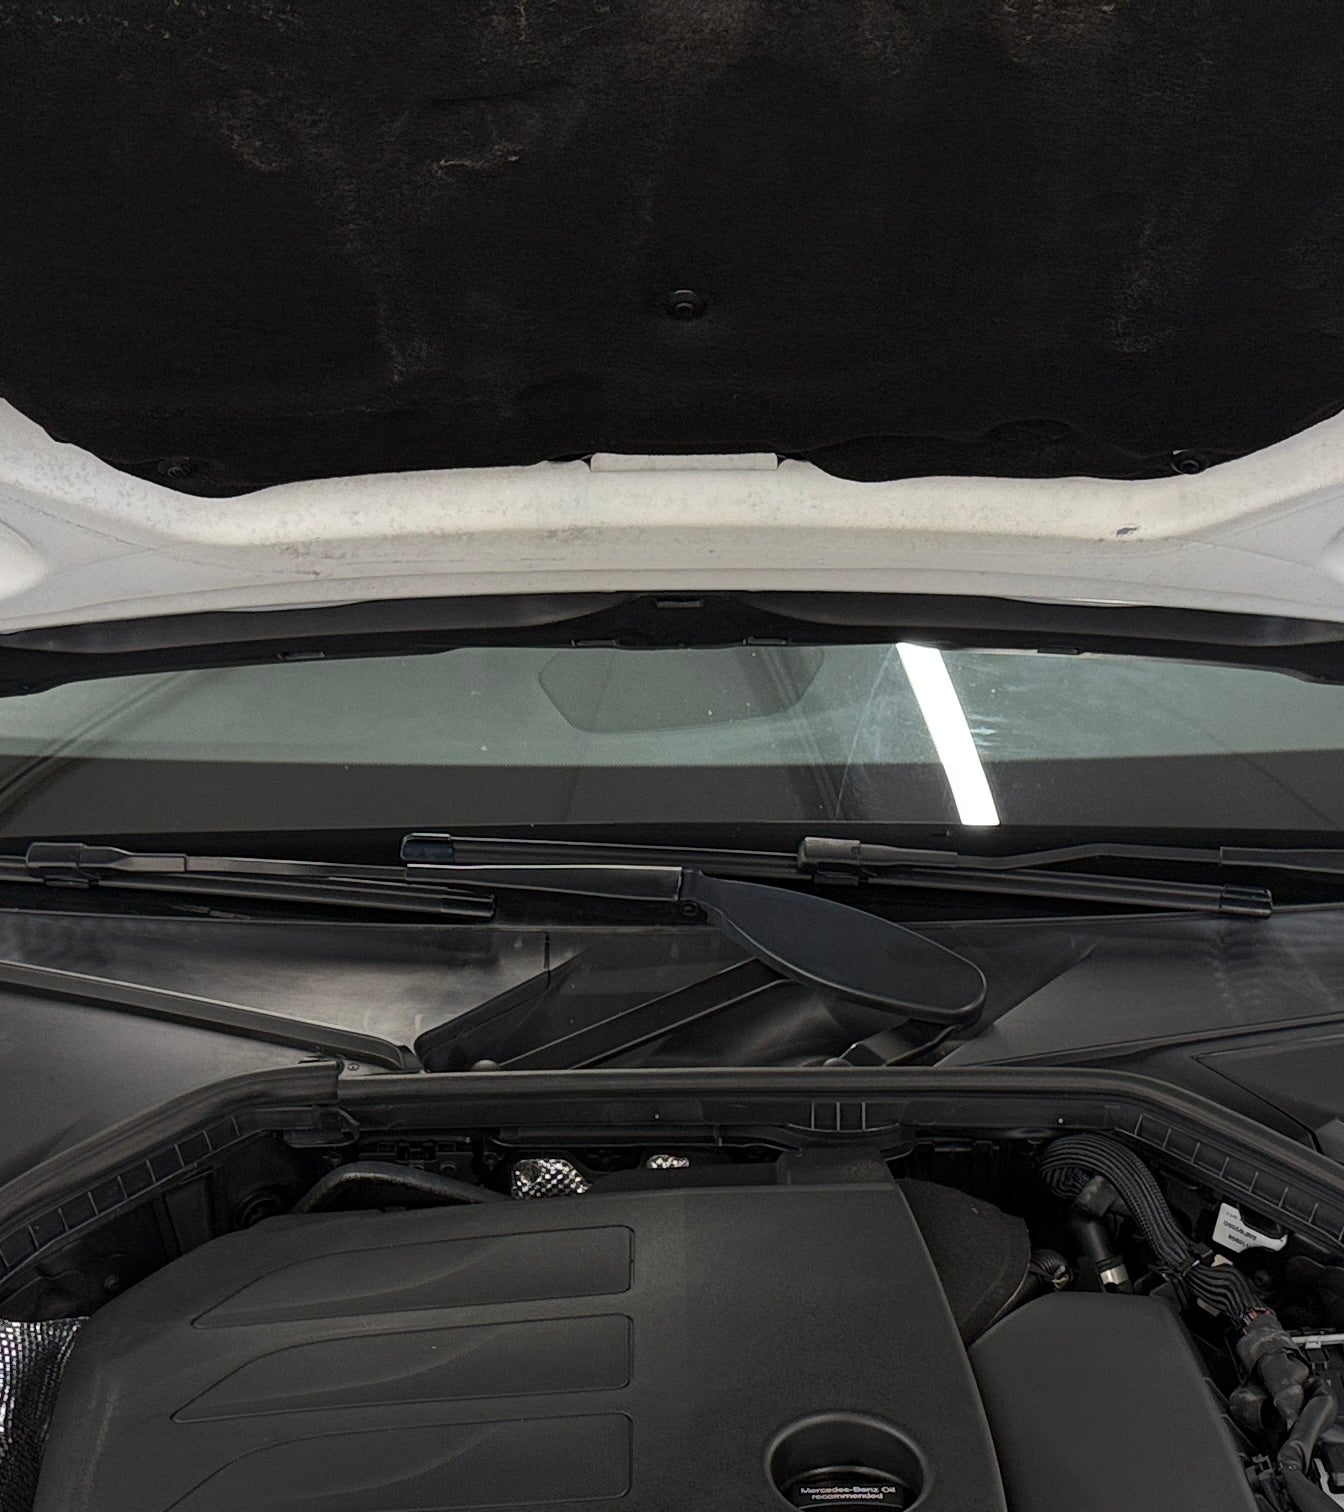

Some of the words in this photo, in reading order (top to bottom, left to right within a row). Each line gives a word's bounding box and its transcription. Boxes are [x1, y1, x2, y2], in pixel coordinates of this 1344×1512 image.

[800, 1486, 880, 1494] Mercedes-Benz
[881, 1486, 896, 1494] Oil
[811, 1492, 884, 1500] recommended
